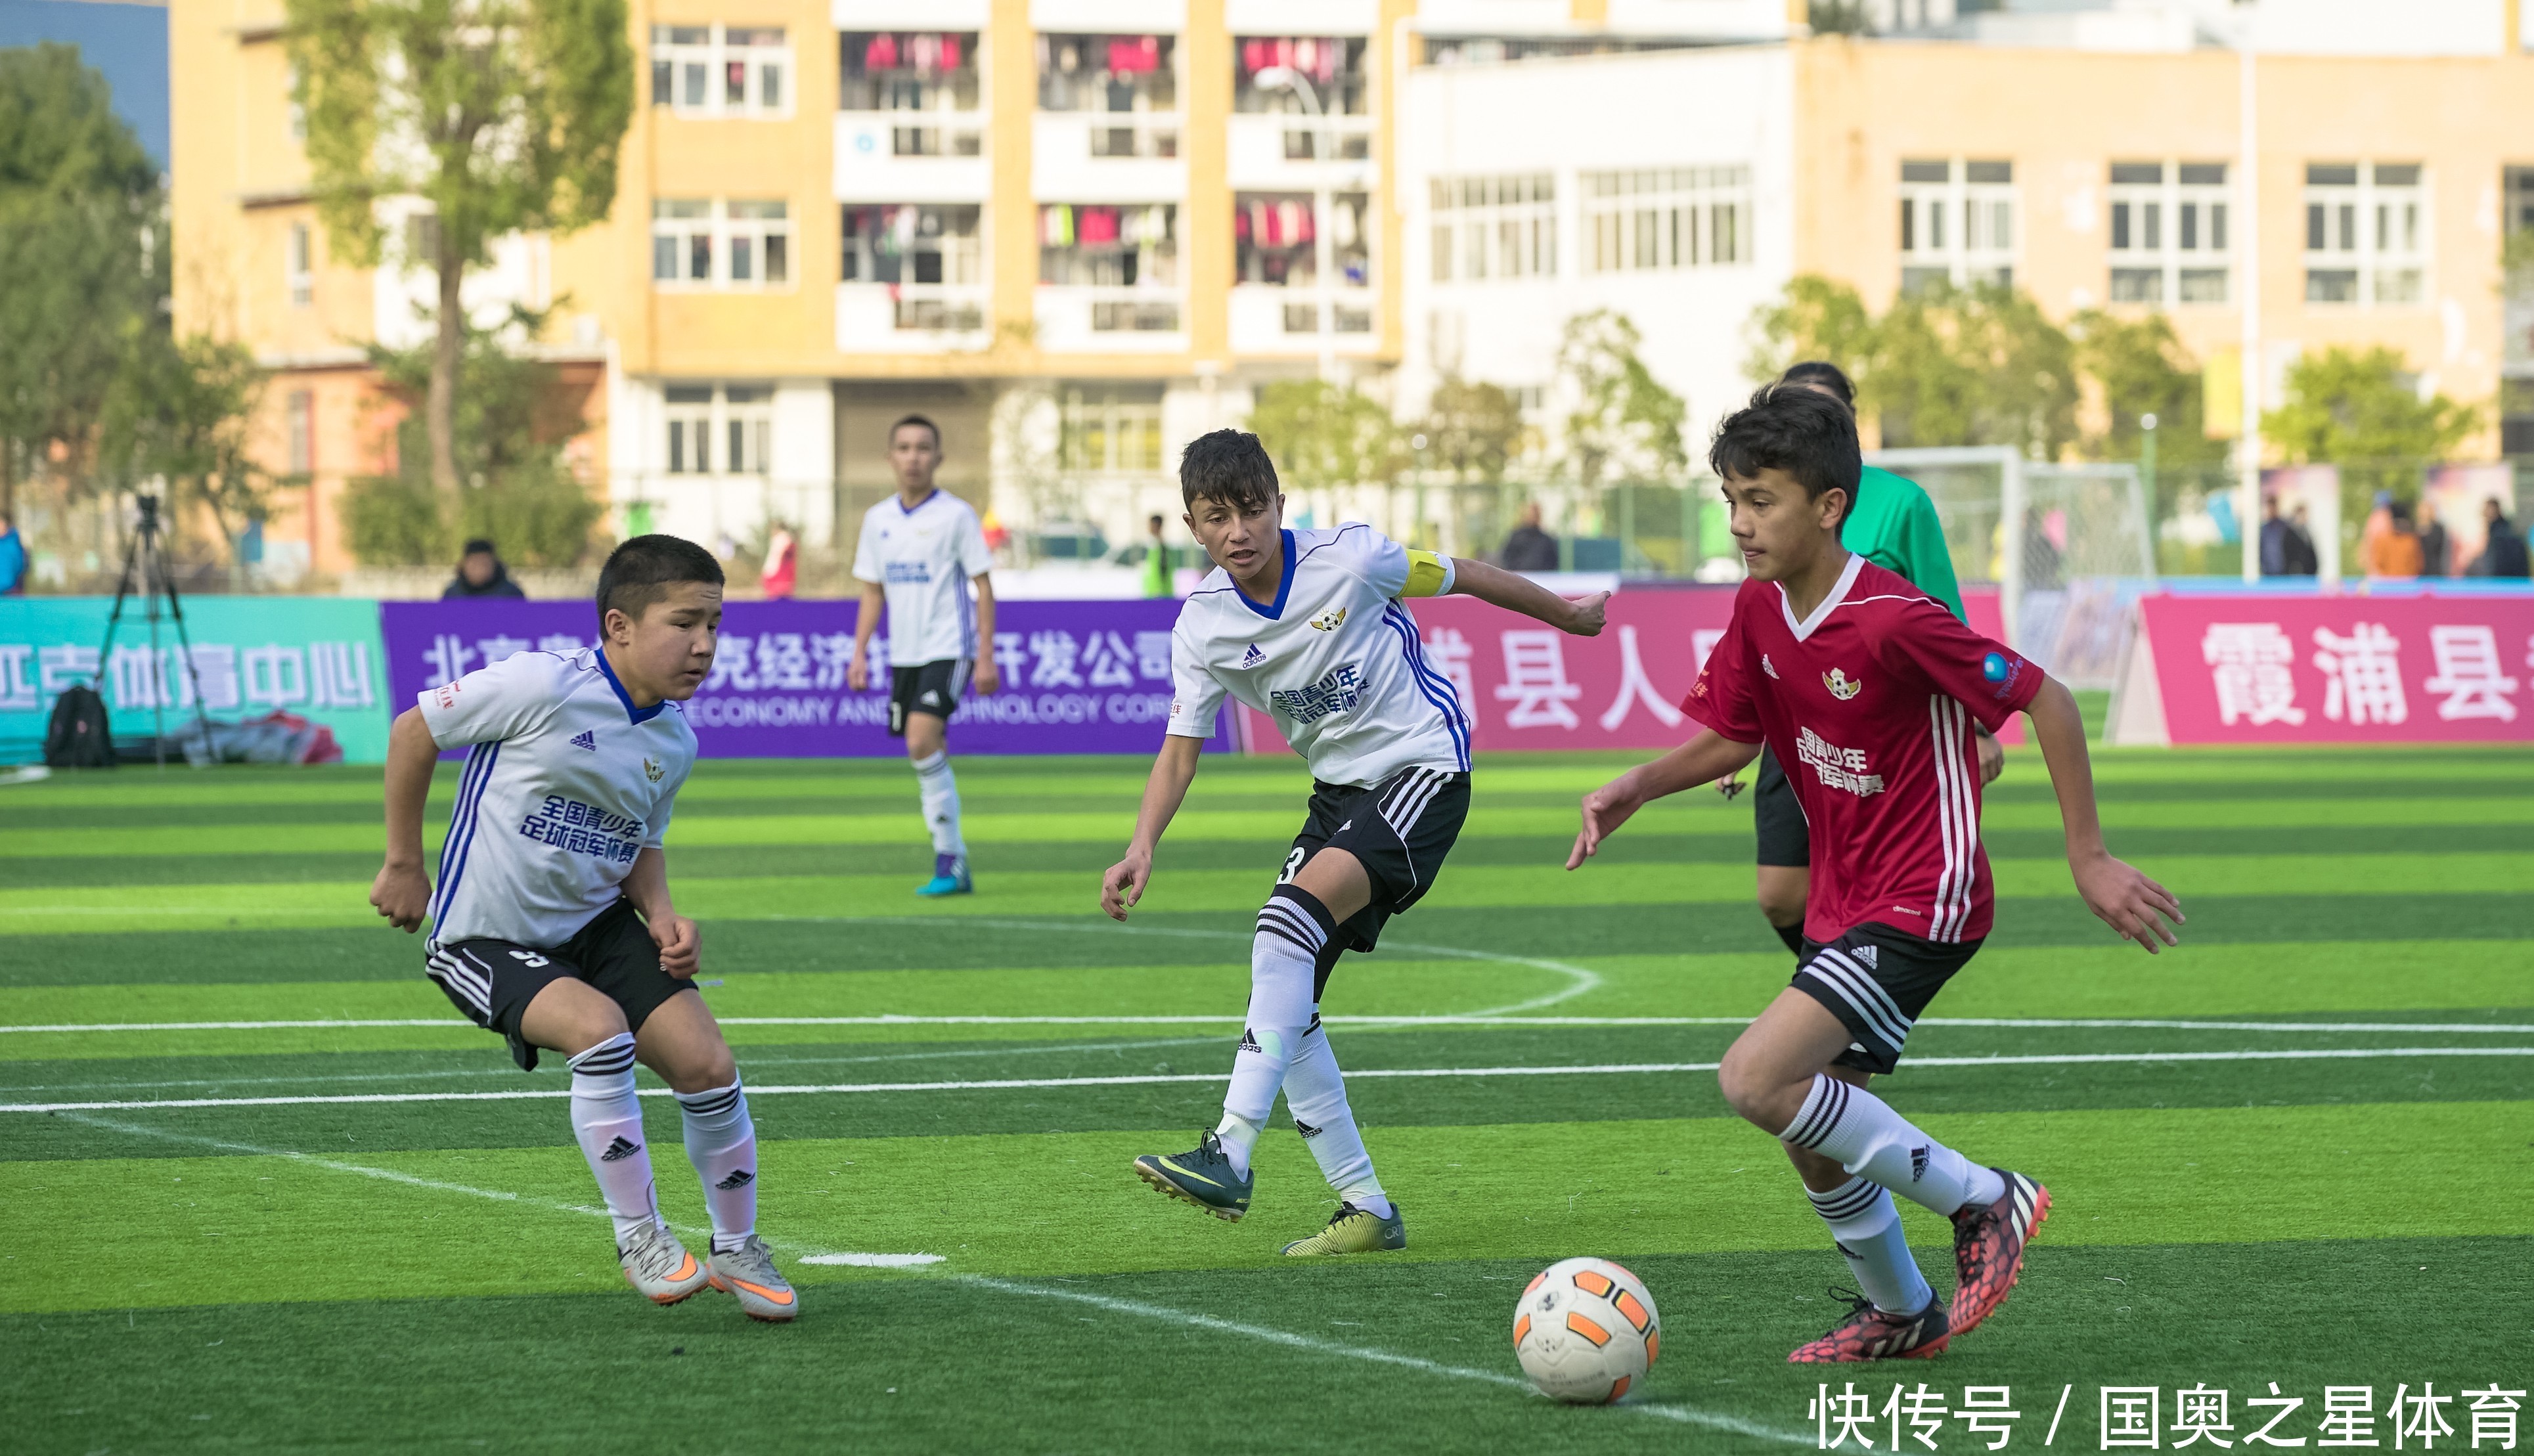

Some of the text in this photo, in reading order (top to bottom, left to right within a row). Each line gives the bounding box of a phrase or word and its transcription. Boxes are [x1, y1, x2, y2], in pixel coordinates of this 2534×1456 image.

[1243, 654, 1266, 669] adidas
[2202, 621, 2534, 726] 霞浦县
[684, 695, 835, 726] ECONOMY
[1801, 726, 1867, 772] 国青少年
[540, 794, 643, 839] 全国青少年
[519, 814, 640, 864] 足球冠军杯赛
[1276, 847, 1305, 885] 3
[1851, 948, 1878, 970] adidas
